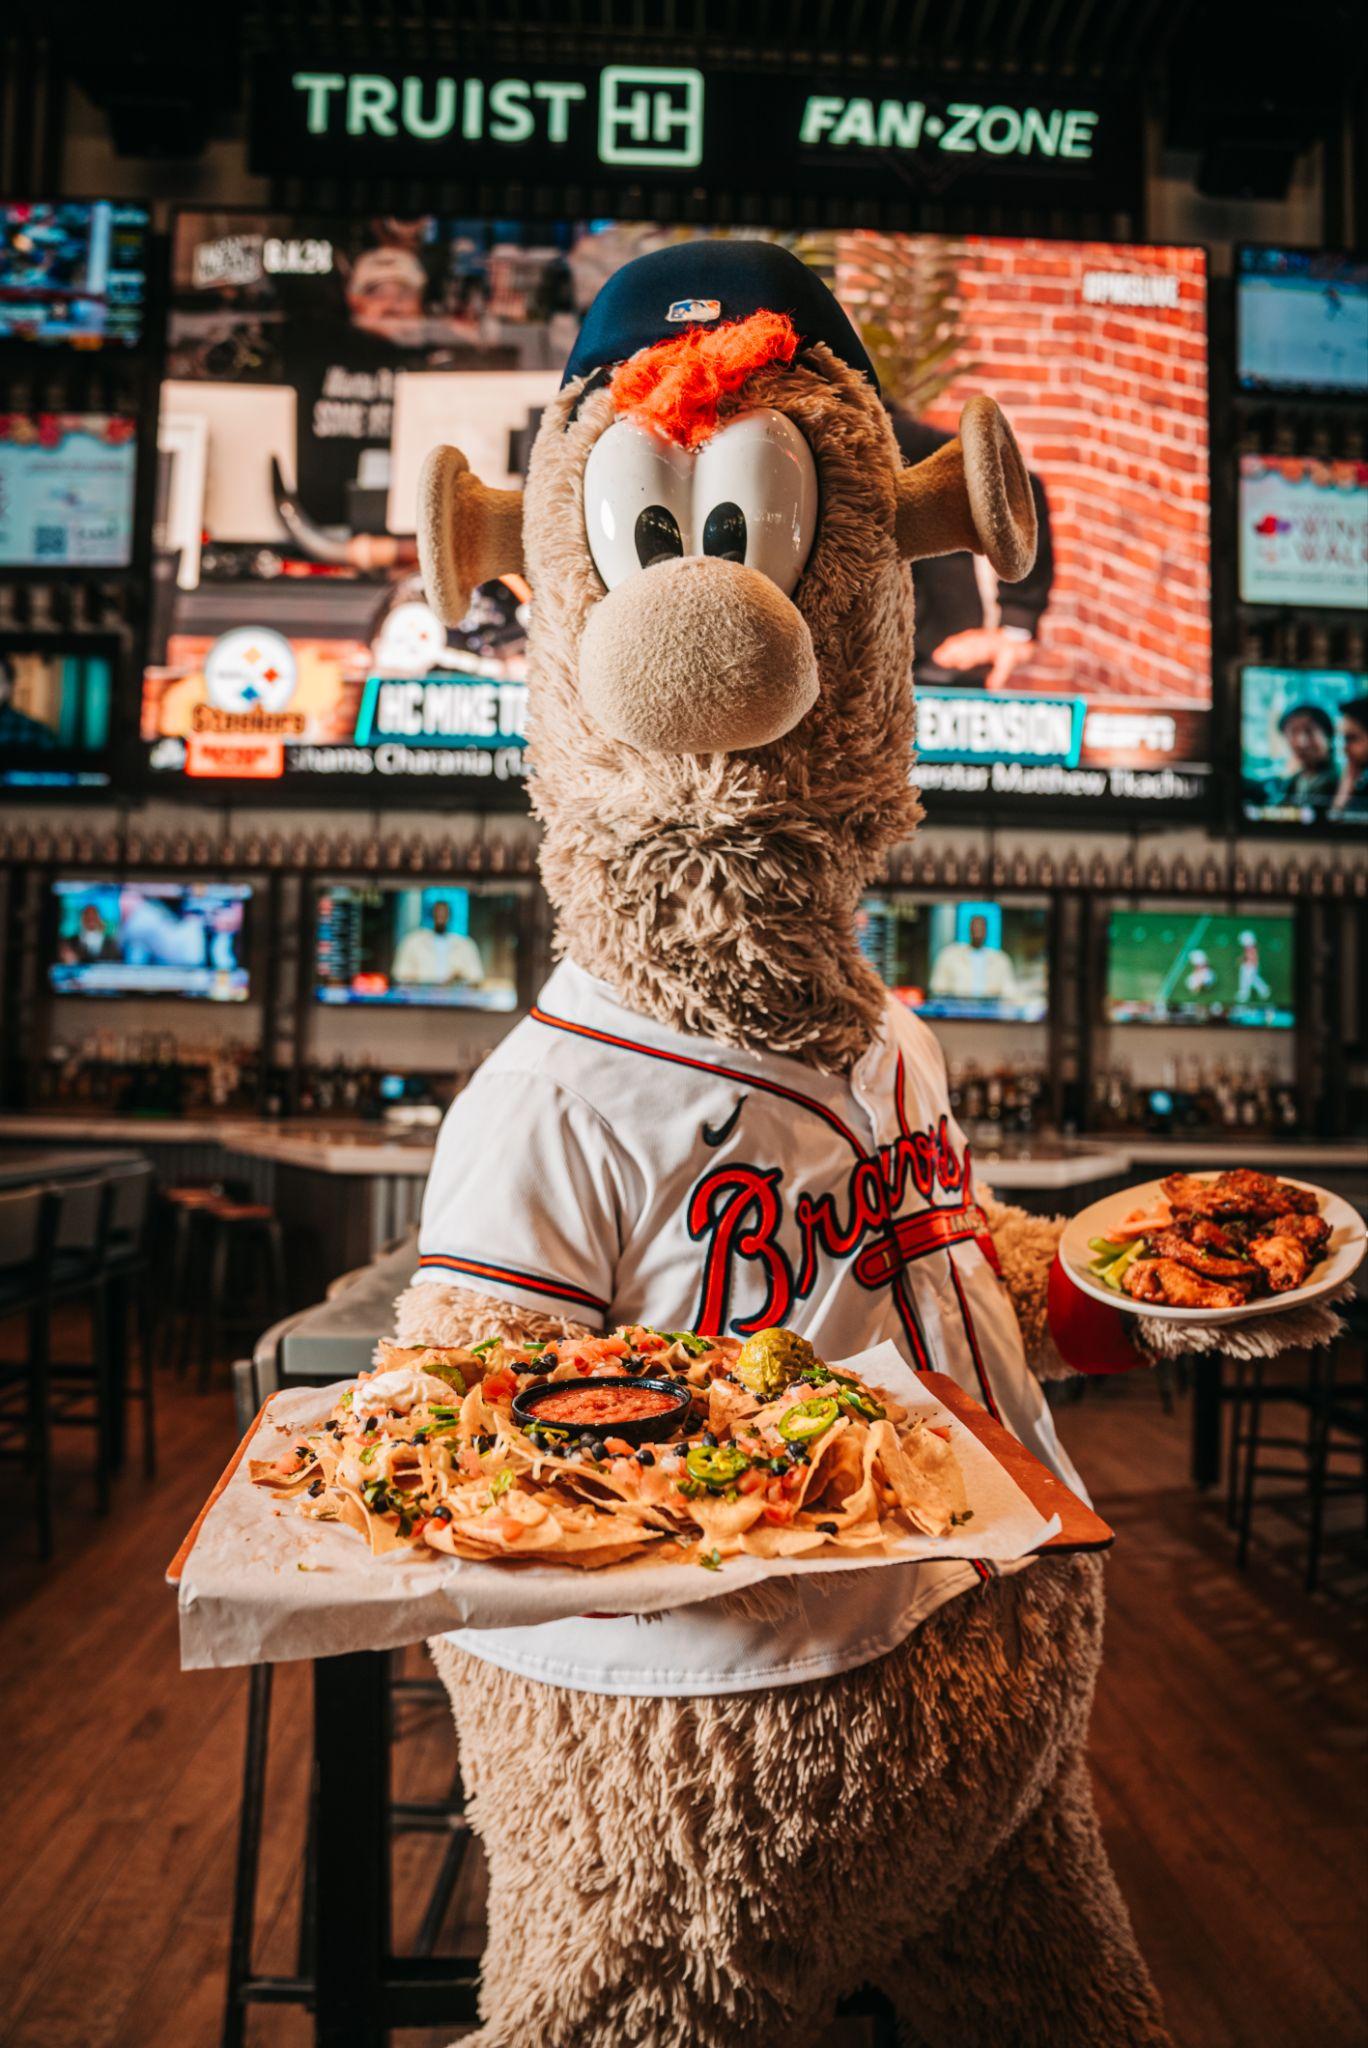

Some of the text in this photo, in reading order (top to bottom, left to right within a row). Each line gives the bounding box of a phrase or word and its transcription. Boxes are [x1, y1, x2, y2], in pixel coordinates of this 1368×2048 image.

[292, 72, 586, 142] TRUIST
[424, 683, 496, 737] MIKE
[917, 698, 1072, 755] EXTENSION
[991, 762, 1107, 796] Matthew
